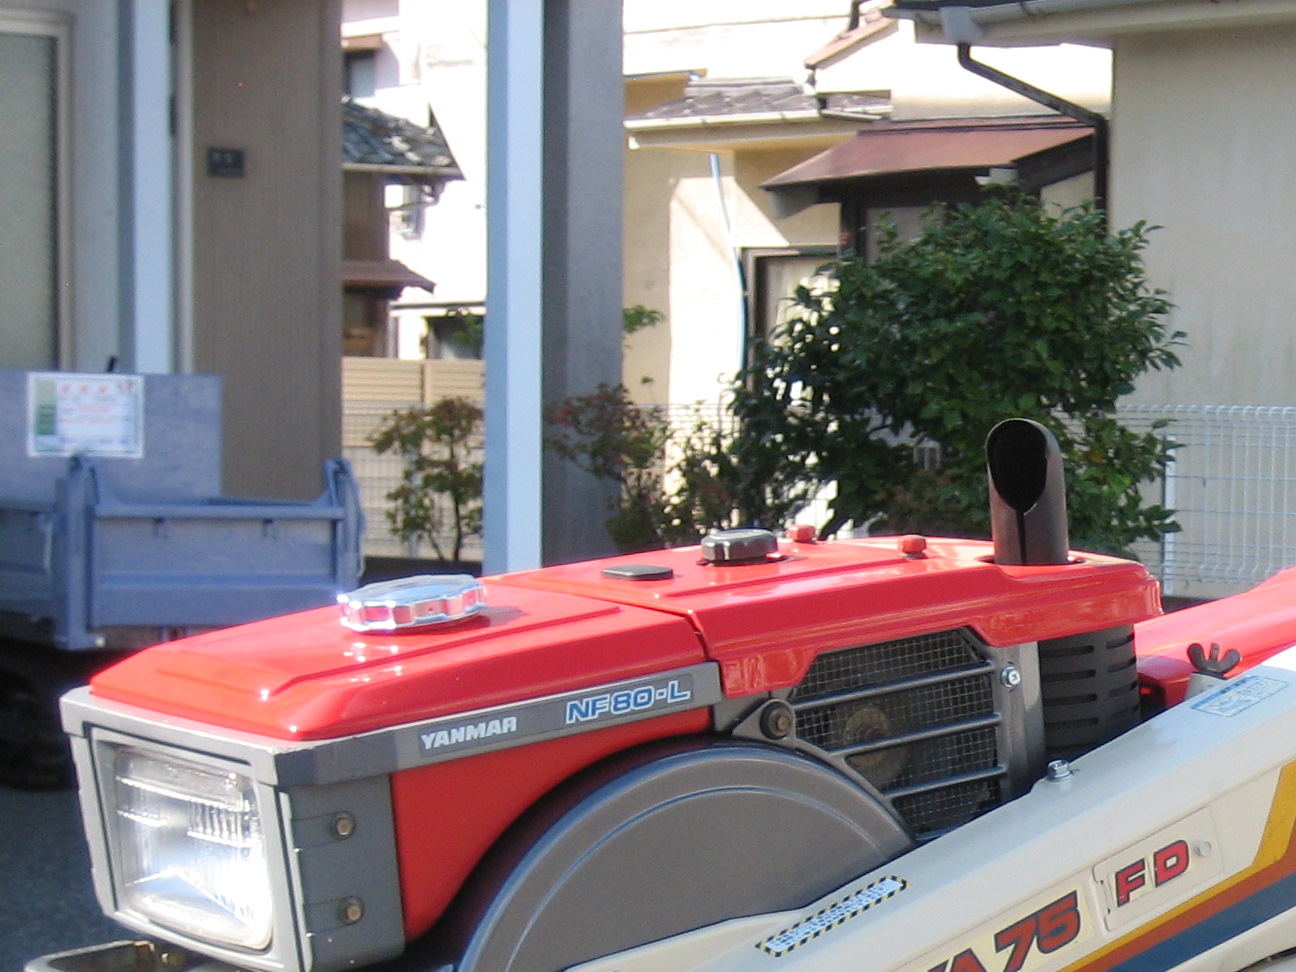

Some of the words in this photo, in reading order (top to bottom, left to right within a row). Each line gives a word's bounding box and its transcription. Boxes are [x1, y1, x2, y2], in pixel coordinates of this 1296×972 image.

[420, 716, 518, 750] YANMAR
[565, 680, 692, 725] NF80-L
[1114, 839, 1191, 908] FD
